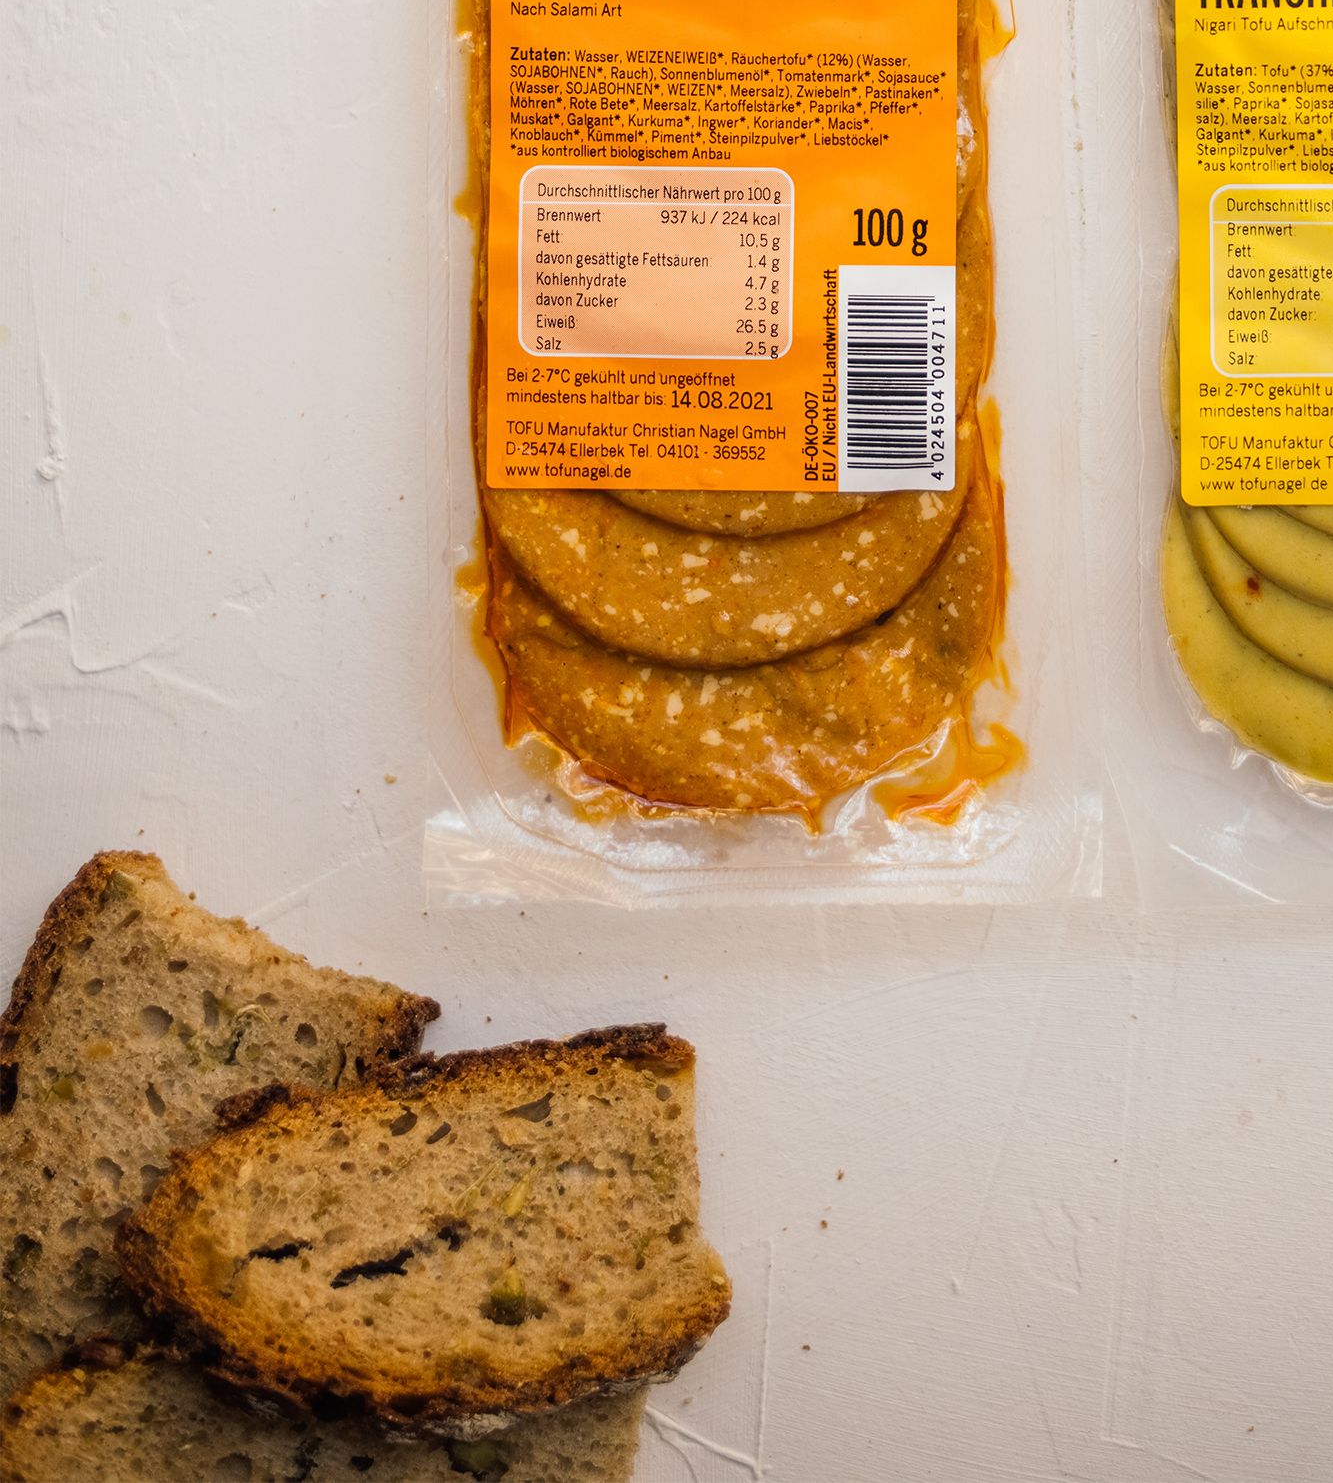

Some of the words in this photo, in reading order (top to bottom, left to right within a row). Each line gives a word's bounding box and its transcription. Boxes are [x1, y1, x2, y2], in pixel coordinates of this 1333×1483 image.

[510, 1, 546, 15] Nach
[550, 2, 597, 16] Salami
[601, 3, 621, 17] Art
[1194, 18, 1236, 35] Nigari
[1240, 17, 1272, 30] Tofu
[510, 46, 570, 61] Zutaten:
[574, 49, 622, 63] Wasser,
[816, 53, 853, 68] (12%)
[856, 53, 910, 68] (Wasser,
[610, 67, 656, 81] Rauch),
[1194, 63, 1256, 77] Zutaten:
[509, 80, 562, 95] (Wasser,
[730, 84, 792, 99] Meersalz),
[541, 144, 606, 158] kontrolliert
[610, 146, 688, 161] biologischem
[691, 146, 730, 160] Anbau
[537, 182, 659, 199] Durchschnittlischer
[662, 185, 719, 200] Nährwert
[723, 189, 744, 203] pro
[747, 187, 771, 201] 100
[773, 189, 781, 204] g
[660, 209, 687, 224] 937
[691, 209, 706, 225] kJ
[709, 210, 718, 225] /
[721, 210, 748, 225] 224
[752, 210, 780, 226] kcal
[854, 208, 904, 246] 100
[911, 217, 928, 256] g
[771, 235, 780, 250] g
[535, 251, 572, 265] davon
[575, 251, 639, 269] gesättigte
[771, 257, 780, 272] g
[770, 278, 779, 293] g
[535, 292, 572, 306] davon
[770, 299, 779, 314] g
[769, 322, 778, 337] g
[822, 268, 837, 402] EU-Landwirtschaft
[931, 305, 946, 378] 004711
[769, 344, 778, 359] g
[506, 368, 527, 382] Bei
[531, 368, 570, 383] 2-7°C
[574, 369, 625, 387] gekühlt
[629, 371, 655, 384] und
[659, 371, 735, 388] ungeöffnet
[506, 389, 586, 404] mindestens
[590, 390, 639, 405] haltbar
[643, 391, 666, 406] bis:
[670, 390, 773, 410] 14.08.2021
[1199, 382, 1220, 397] Bei
[1224, 382, 1264, 397] 2-7°C
[1268, 382, 1320, 399] gekühlt
[1199, 403, 1281, 418] mindestens
[506, 420, 543, 435] TOFU
[547, 421, 627, 437] Manufaktur
[632, 423, 694, 438] Christian
[699, 424, 738, 442] Nagel
[741, 425, 786, 440] GmbH
[822, 409, 836, 445] Nicht
[931, 389, 944, 462] 024504
[801, 390, 818, 480] DE-ÖKO-007
[1200, 435, 1237, 450] TOFU
[1242, 435, 1323, 450] Manufaktur
[506, 441, 565, 456] D-25474
[569, 442, 624, 458] Ellerbek
[656, 443, 699, 459] 04101
[712, 445, 765, 460] 369552
[822, 449, 834, 459] /
[505, 462, 631, 481] www.tofunagel.de
[1200, 455, 1260, 470] D-25474
[1265, 455, 1320, 470] Ellerbek
[822, 465, 835, 481] EU
[930, 469, 944, 480] 4
